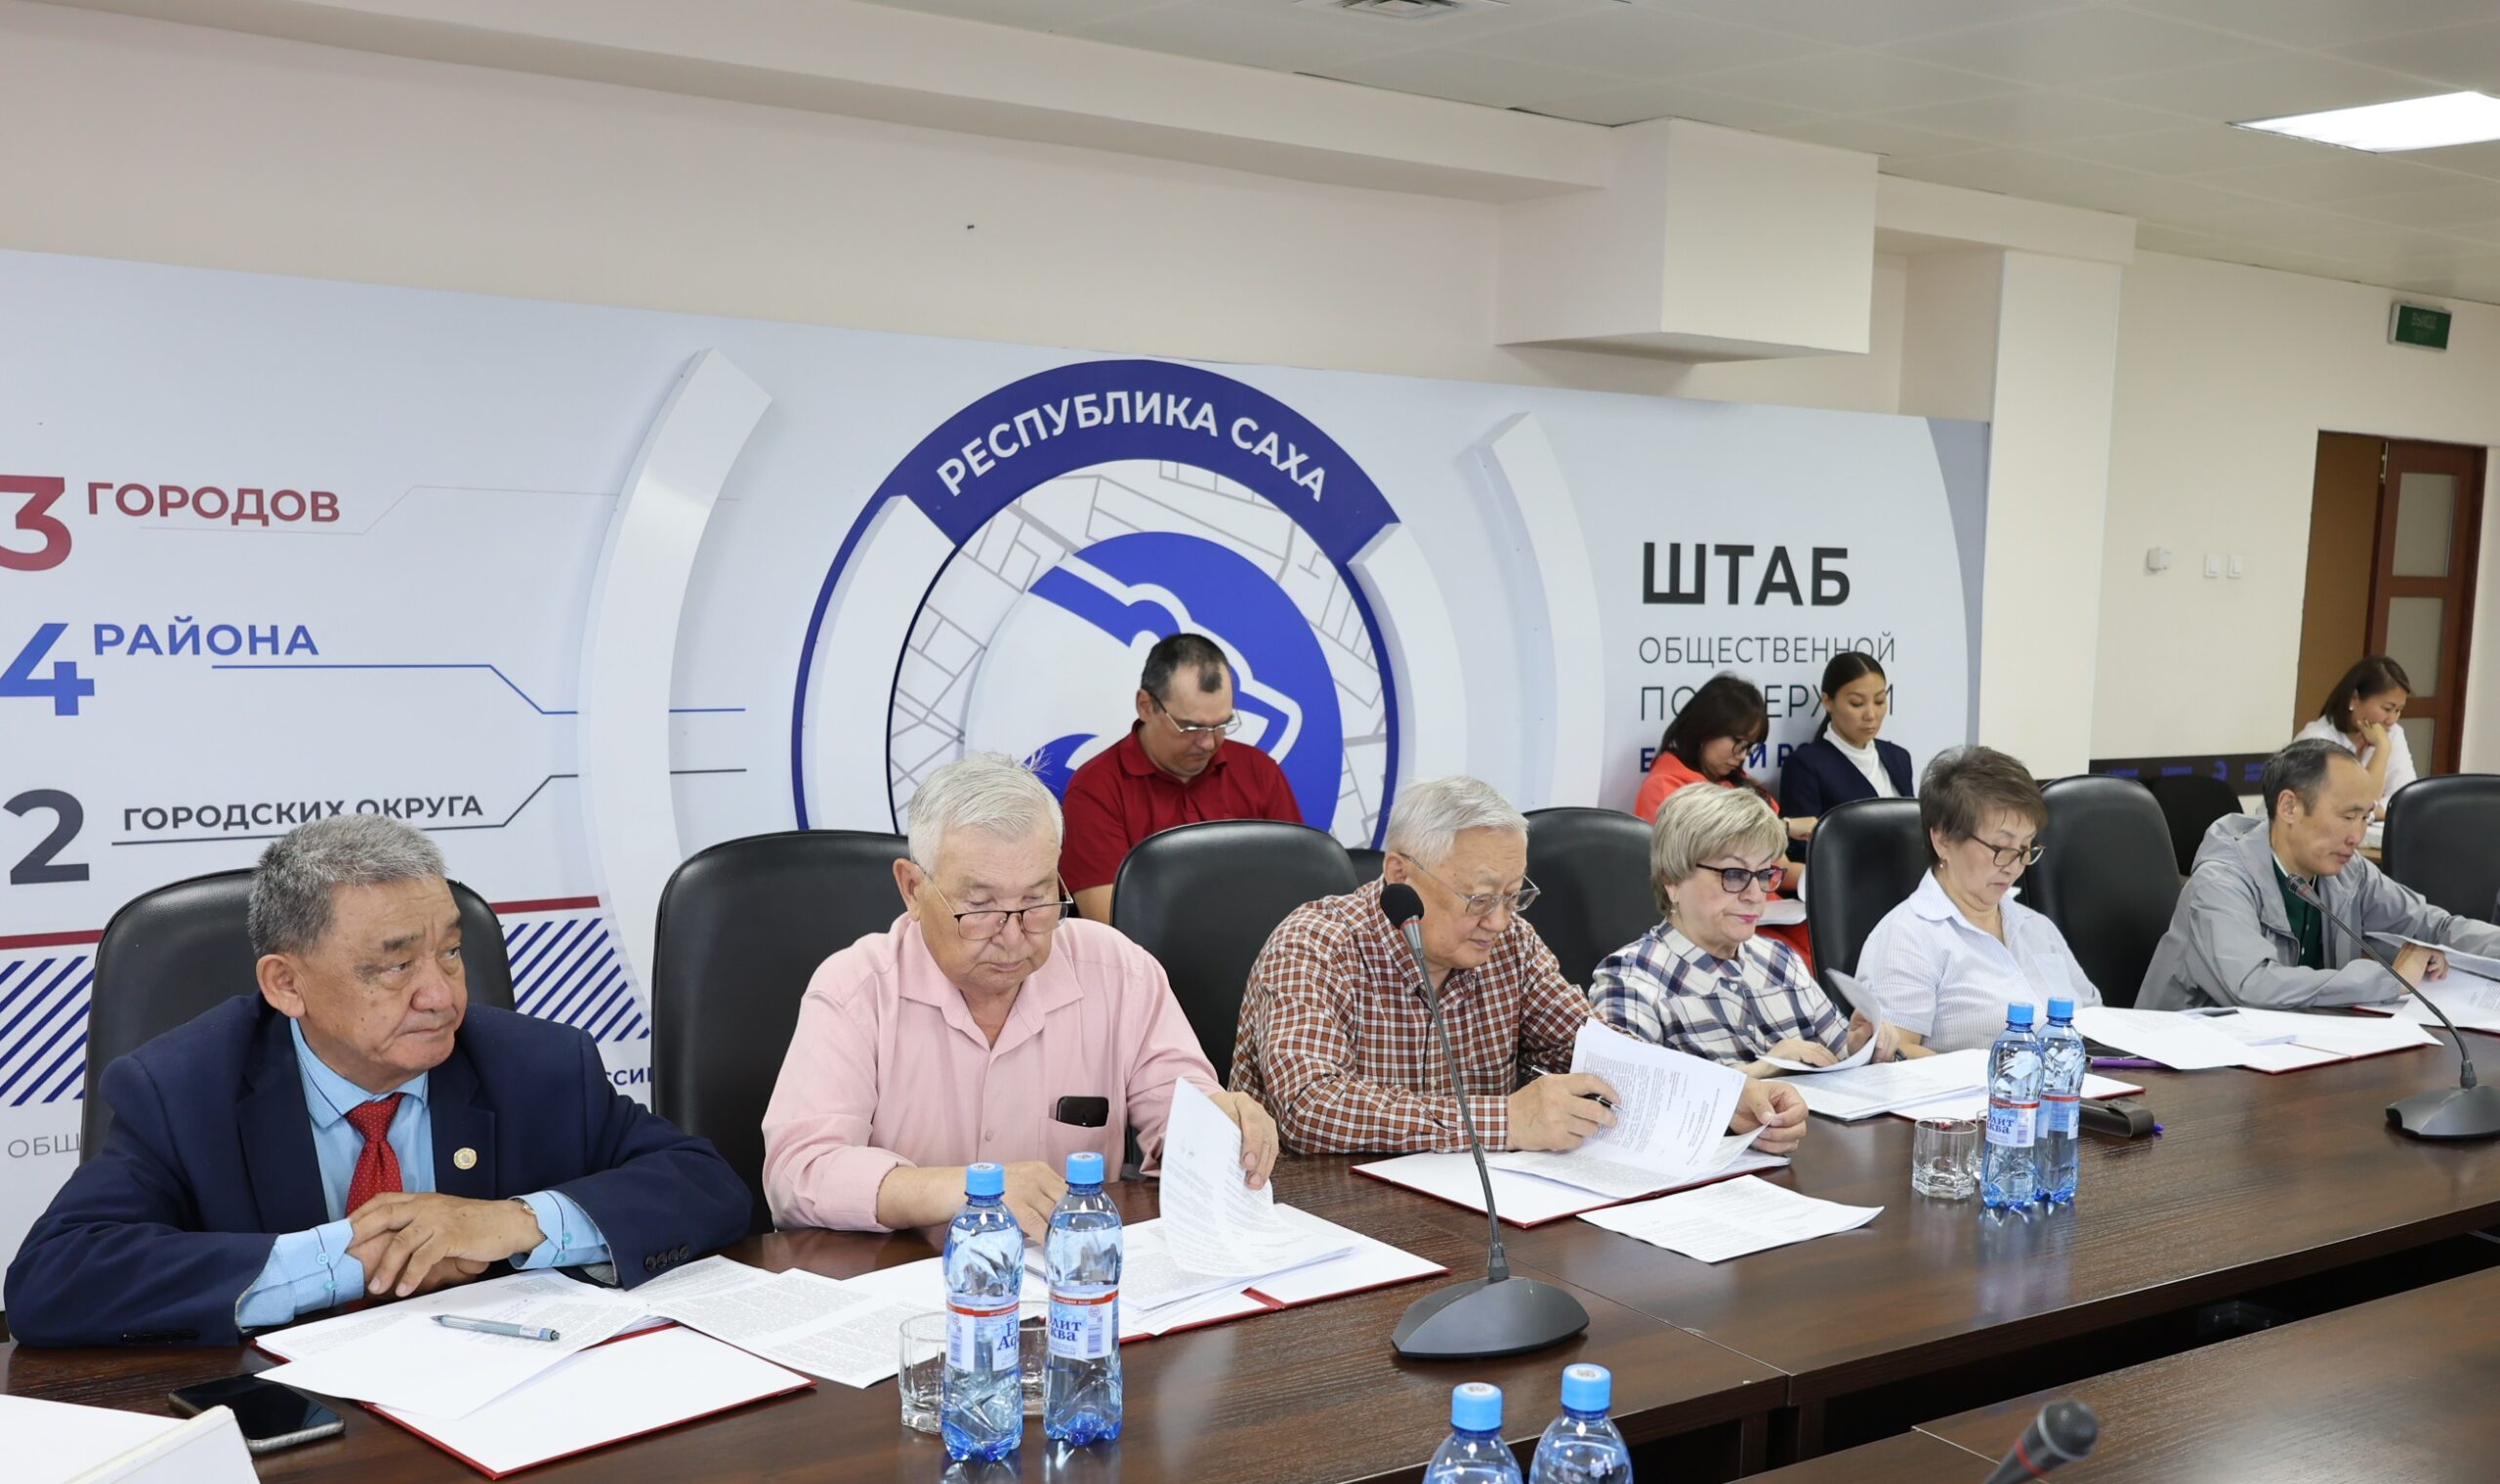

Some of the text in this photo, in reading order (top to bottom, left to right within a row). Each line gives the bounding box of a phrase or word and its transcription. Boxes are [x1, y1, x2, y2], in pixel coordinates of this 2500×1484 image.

[937, 391, 1327, 502] РЕСПУБЛИКА САХА
[88, 482, 340, 527] ГОРОДОВ
[1643, 542, 1851, 606] ШТАБ
[0, 616, 319, 717] 4 РАЙОНА
[1639, 631, 1895, 669] ОБЩЕСТВЕННОЙ
[3, 789, 483, 886] 2 ГОРОДСКИХ ОКРУГА
